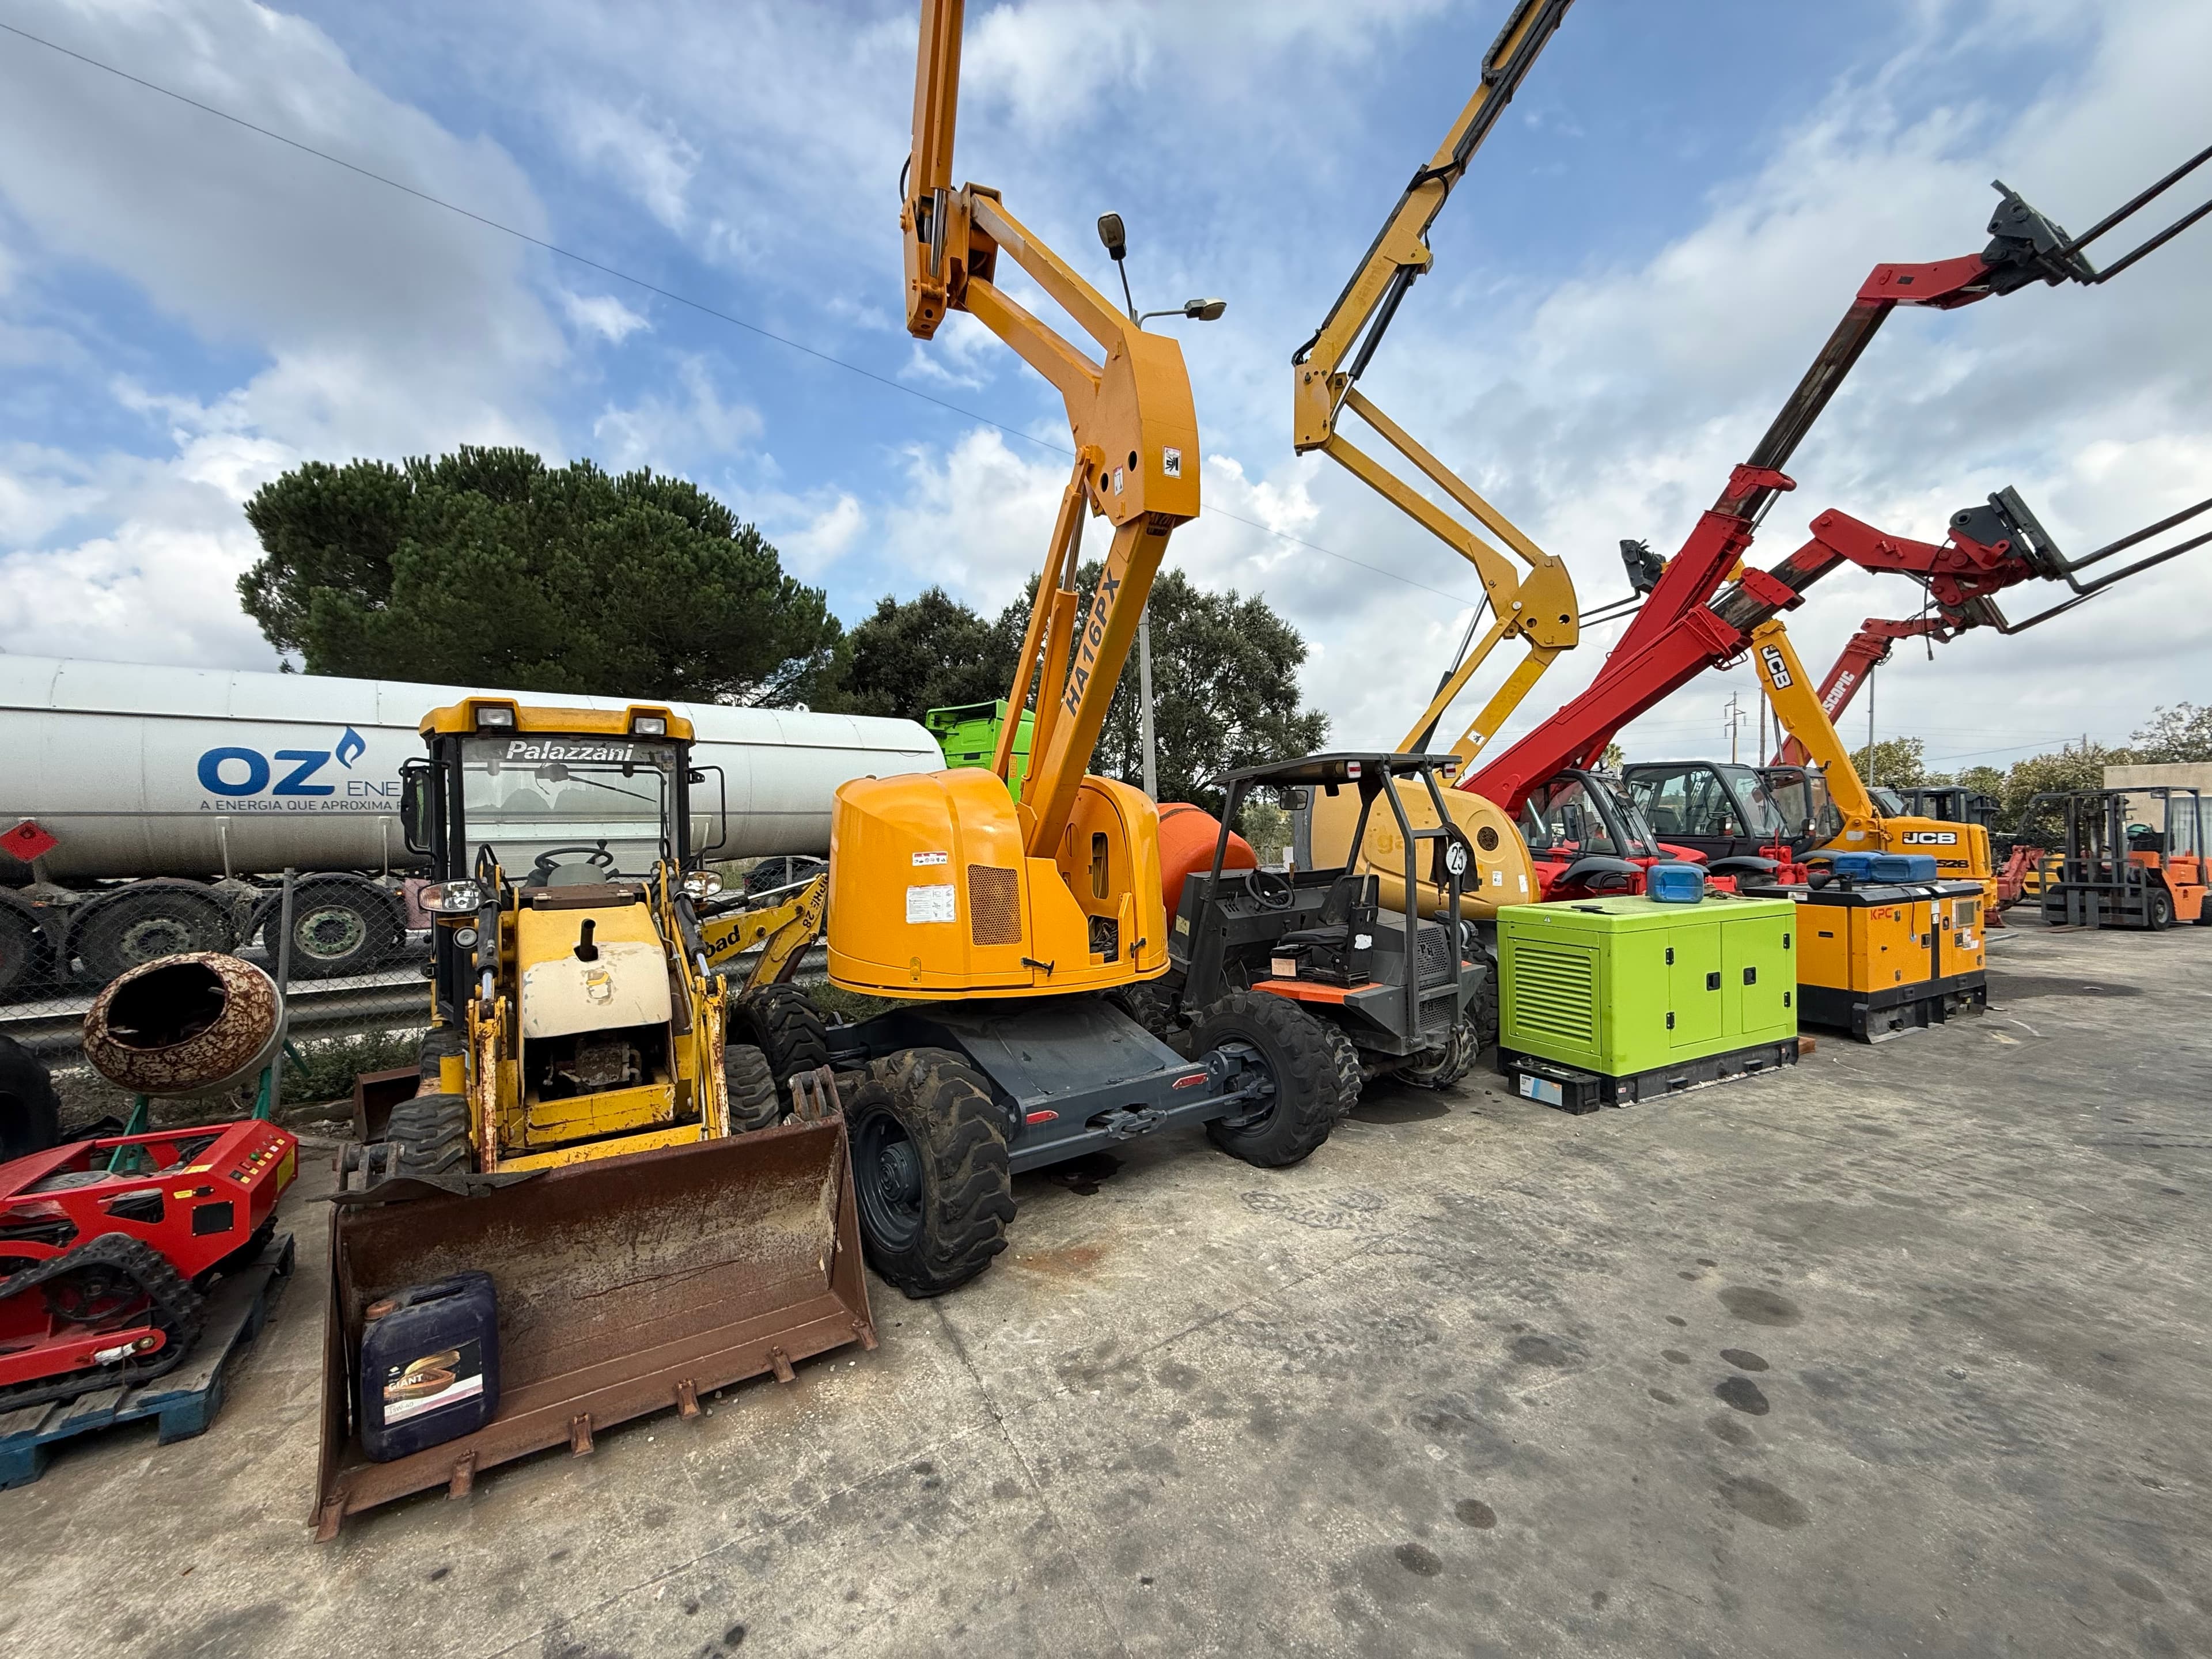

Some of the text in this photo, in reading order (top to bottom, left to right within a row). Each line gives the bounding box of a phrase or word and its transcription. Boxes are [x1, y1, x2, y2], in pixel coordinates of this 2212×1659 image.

[1066, 567, 1120, 717] HA16PX
[1762, 646, 1791, 689] JCB
[506, 741, 634, 761] Palazzani
[198, 747, 335, 796] OZ
[348, 781, 402, 796] ENE
[200, 801, 211, 810] A
[217, 801, 282, 810] ENERGIA
[287, 801, 322, 811] QUE
[326, 801, 392, 810] APROXIMA
[1903, 832, 1956, 844] JCB
[1451, 846, 1464, 870] 25
[1936, 859, 1969, 868] 528
[802, 910, 815, 929] 28
[1870, 907, 1894, 921] KPC
[388, 1373, 424, 1392] GIANT
